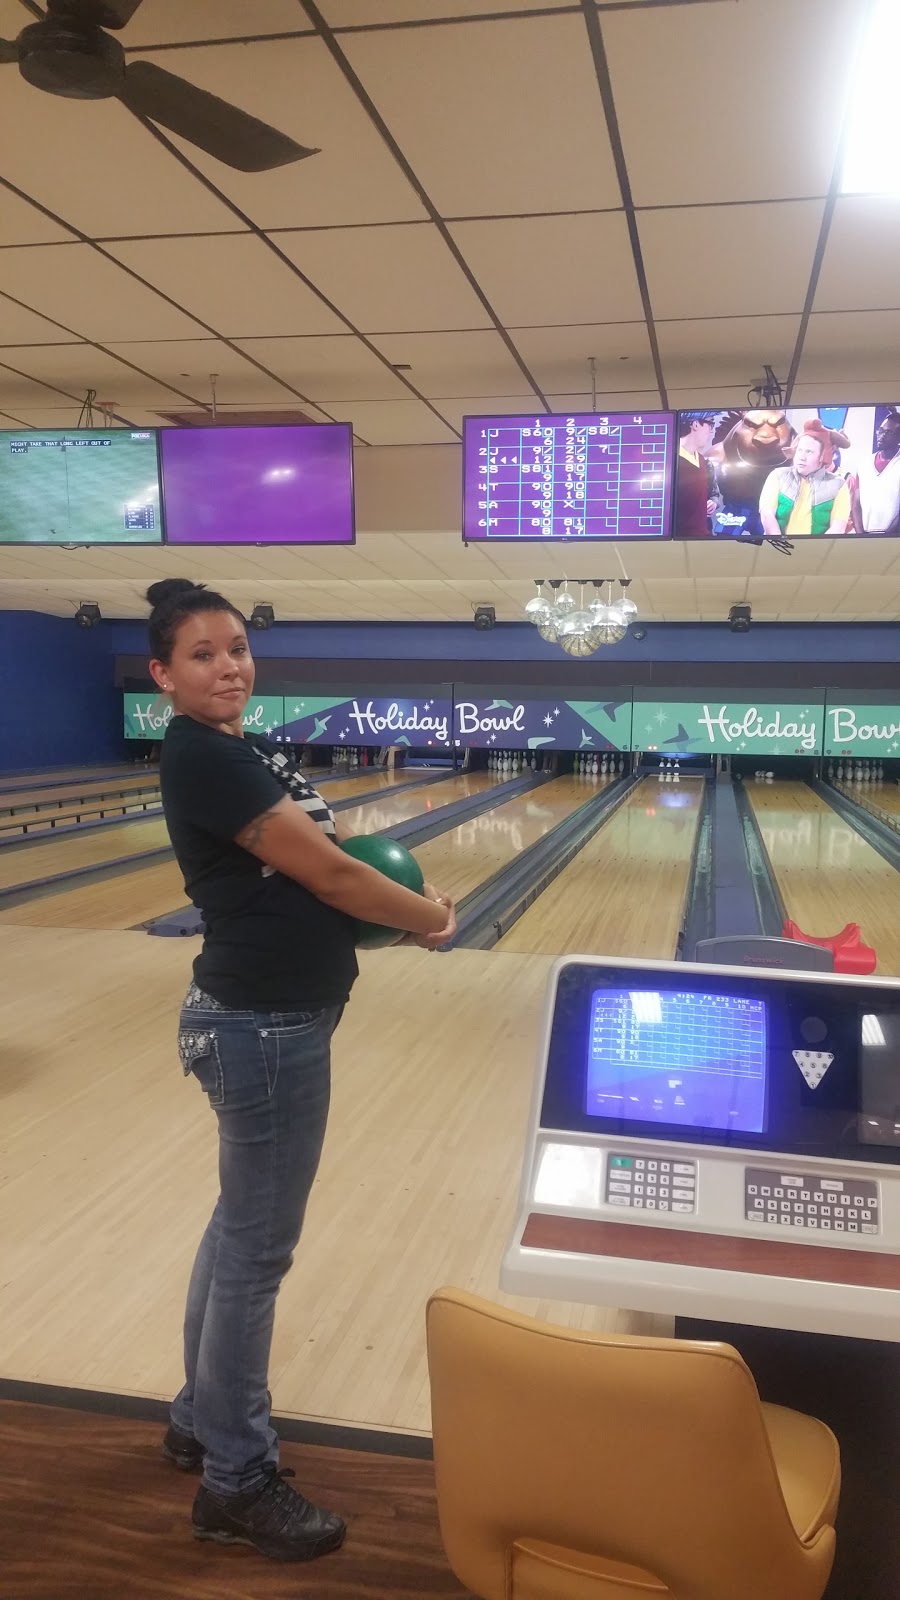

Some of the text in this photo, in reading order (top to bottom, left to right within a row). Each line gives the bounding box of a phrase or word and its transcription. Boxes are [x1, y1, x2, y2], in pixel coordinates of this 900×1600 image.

[349, 701, 525, 740] Holiday Bowl
[698, 706, 900, 749] Holiday Bow
[744, 955, 784, 965] Brunswick
